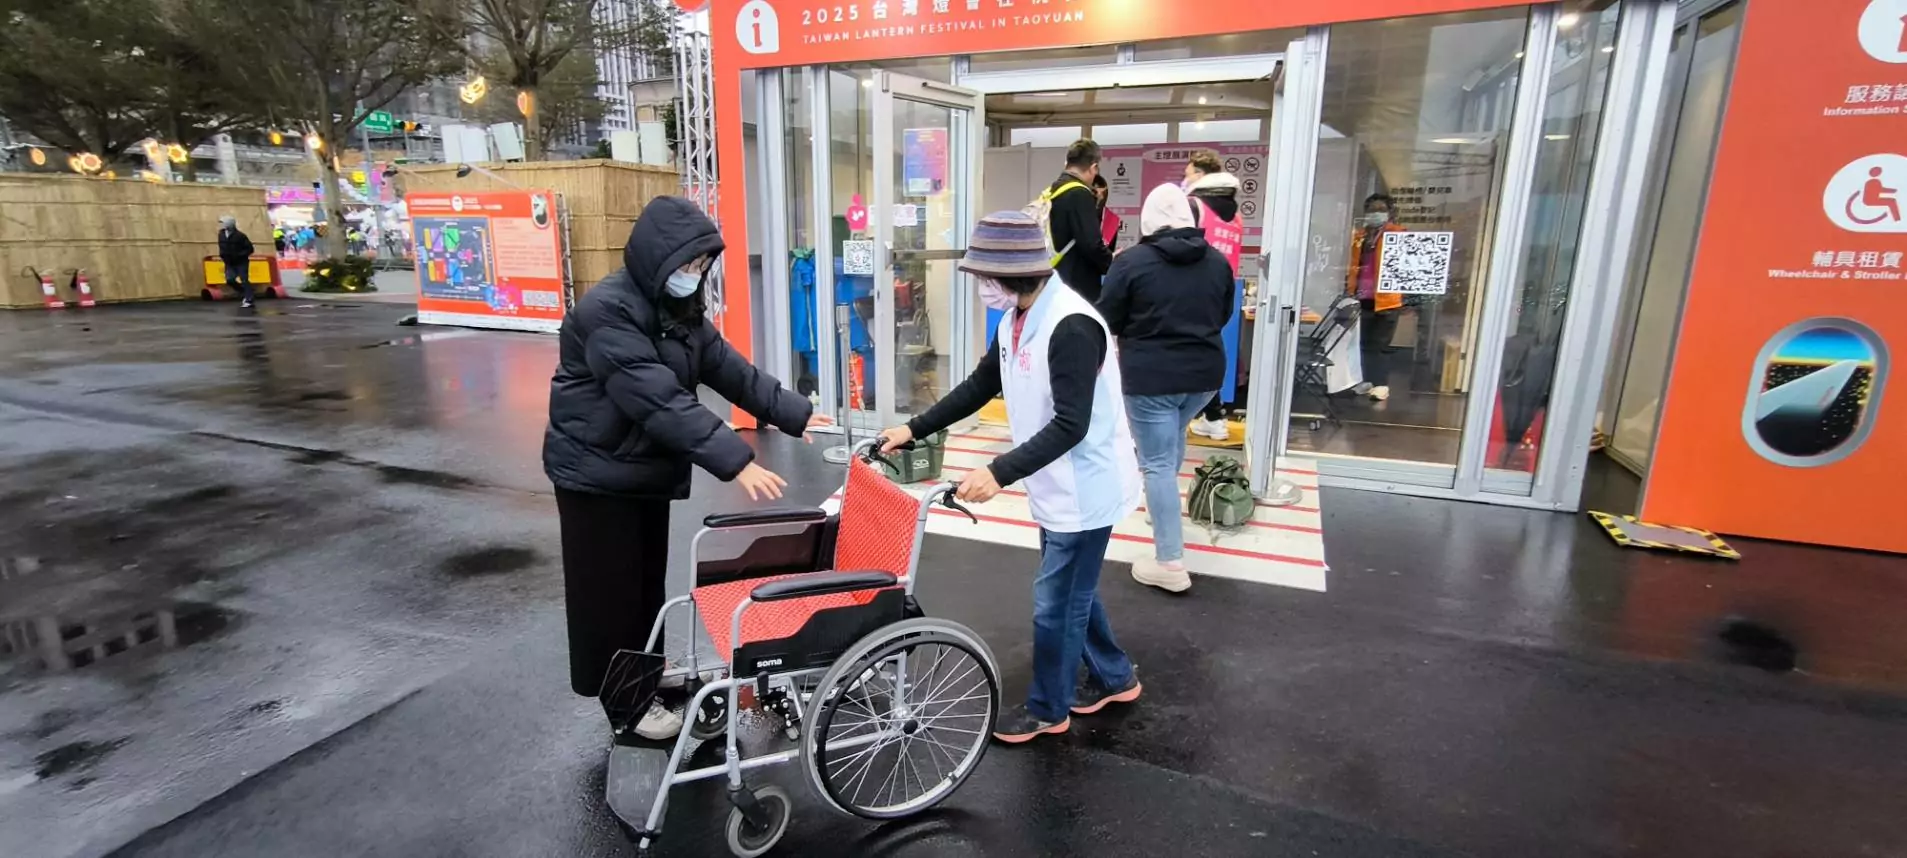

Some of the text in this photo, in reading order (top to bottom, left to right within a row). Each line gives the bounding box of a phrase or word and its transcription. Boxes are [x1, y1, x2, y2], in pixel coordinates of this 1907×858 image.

[802, 4, 859, 25] 2025
[803, 11, 1084, 44] TAIWAN LANTERN FESTIVAL IN TAOYUAN
[1823, 105, 1899, 116] Information
[1812, 250, 1903, 268] 輔具租賃
[1768, 269, 1838, 279] Wheelchair
[1840, 270, 1850, 279] &
[1854, 270, 1902, 280] Stroller
[756, 658, 783, 668] soma
